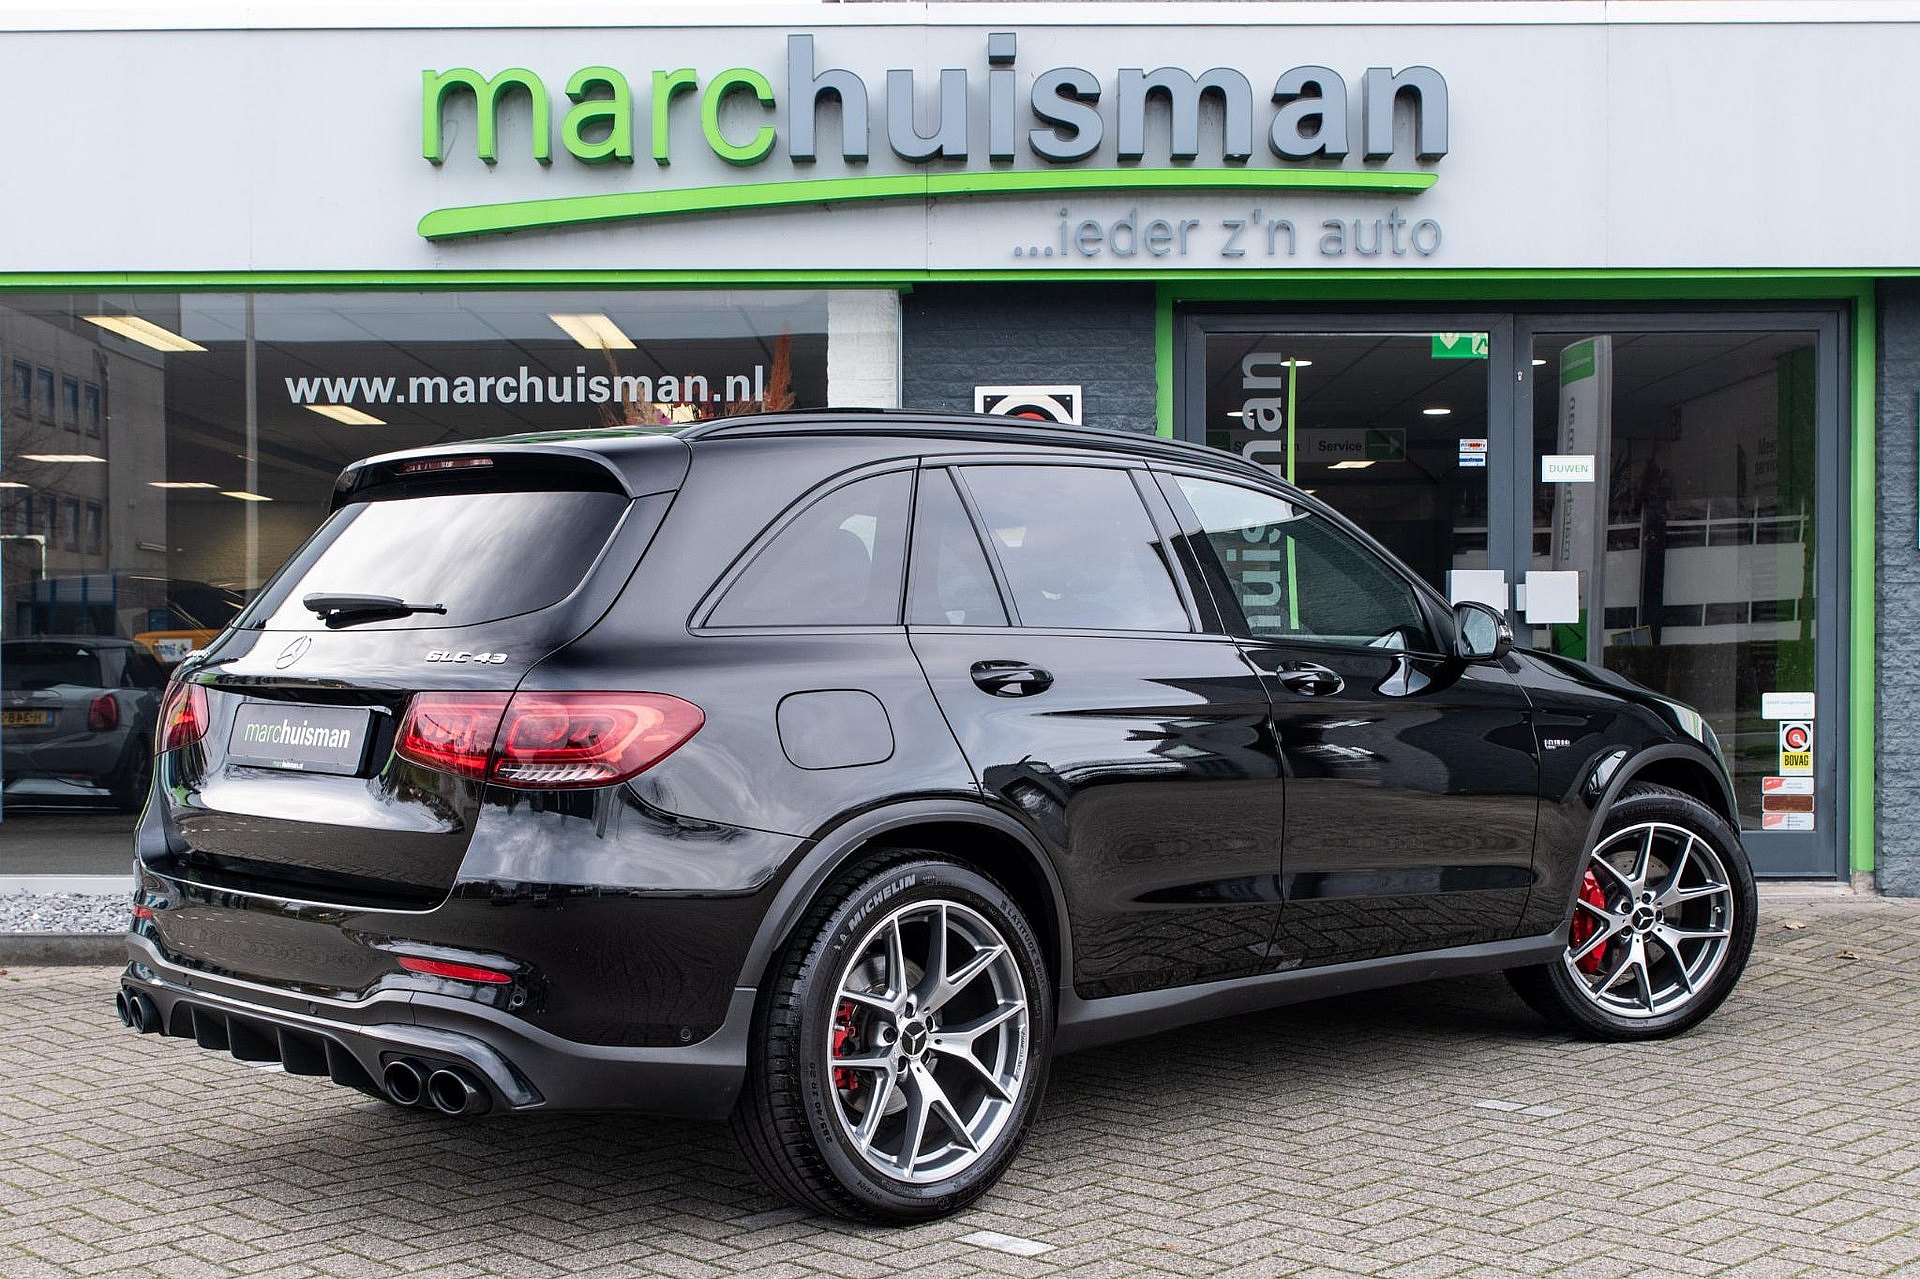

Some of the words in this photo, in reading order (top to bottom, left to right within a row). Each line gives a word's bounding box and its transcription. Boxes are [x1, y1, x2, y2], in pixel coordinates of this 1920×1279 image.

[421, 33, 1449, 165] marchuisman
[1013, 207, 1200, 257] ...ieder
[1221, 208, 1296, 257] z'n
[1319, 206, 1442, 257] auto
[284, 366, 764, 404] www.marchuisman.nl
[1318, 440, 1362, 451] Service
[1549, 464, 1588, 473] DUWEN
[426, 651, 472, 663] GLC
[473, 652, 508, 665] 43
[244, 719, 351, 749] marchuisman
[1784, 755, 1809, 766] BOVAG
[848, 874, 916, 932] MICHELIN
